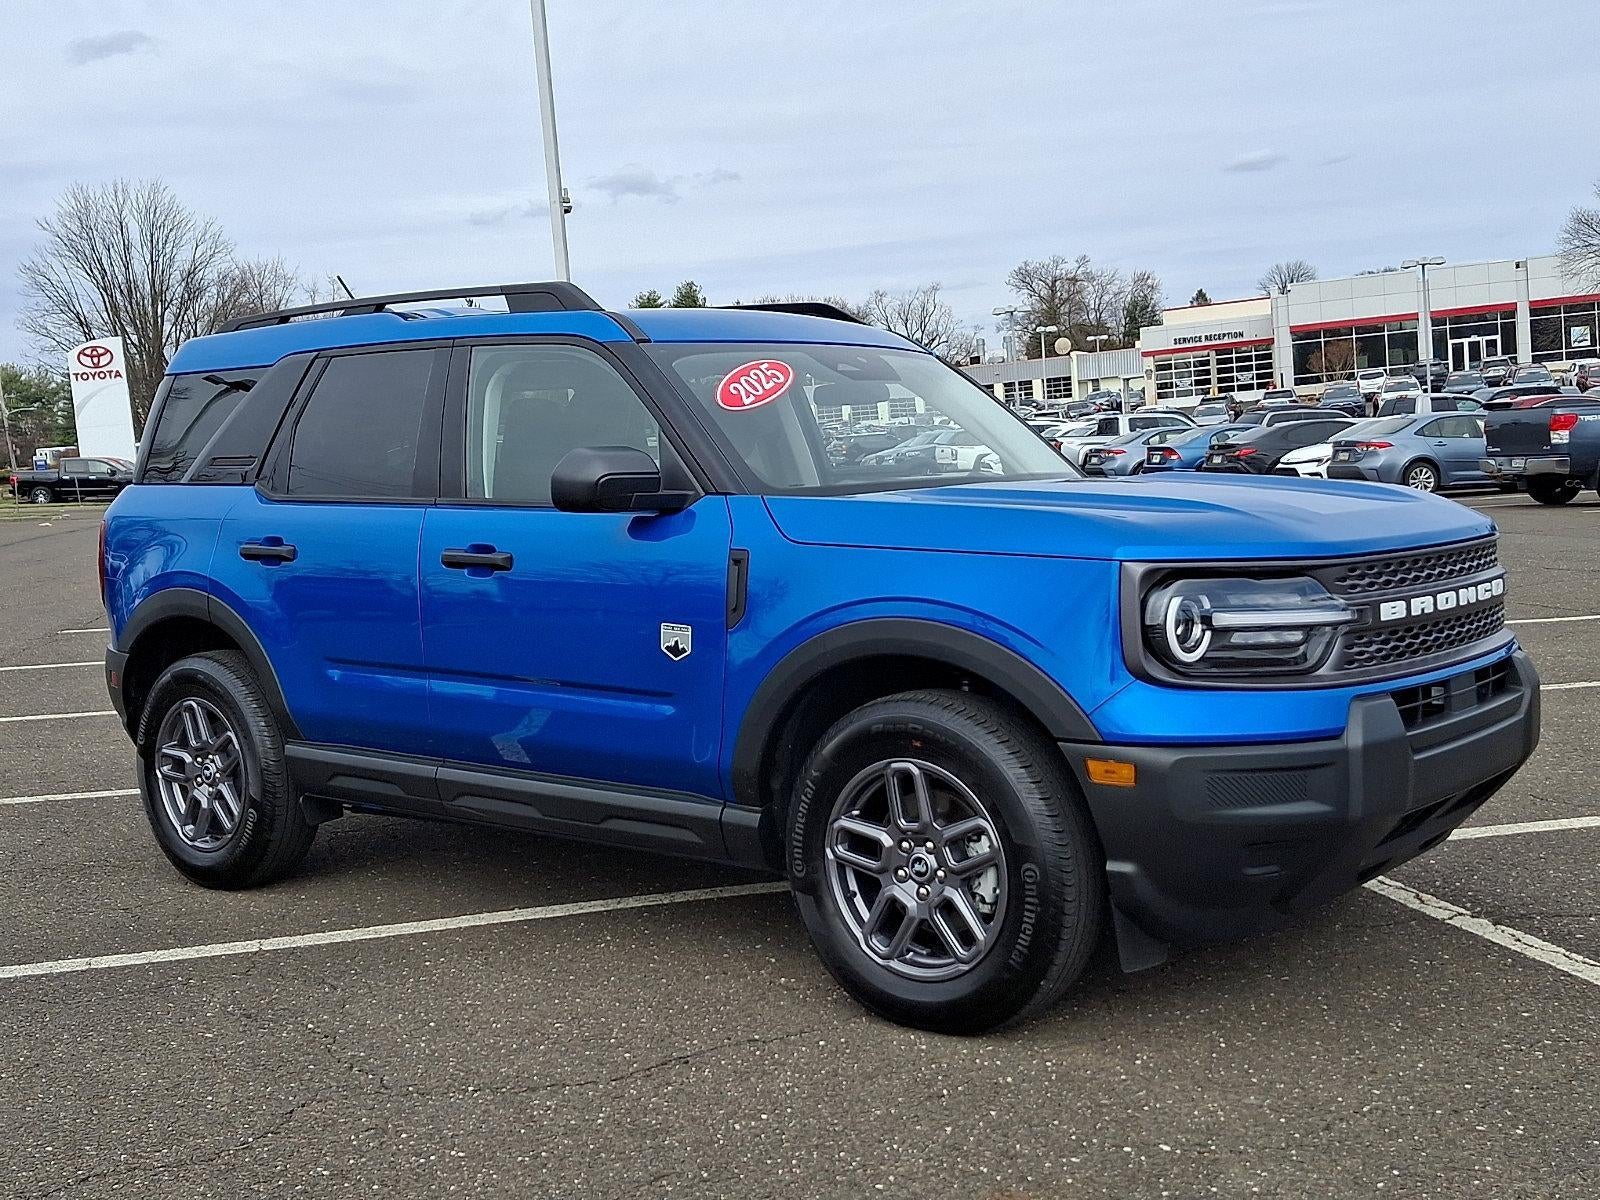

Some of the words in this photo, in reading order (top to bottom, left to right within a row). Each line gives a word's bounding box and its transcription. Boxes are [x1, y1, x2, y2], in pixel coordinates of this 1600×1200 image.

[1173, 335, 1203, 345] SERVICE
[1204, 331, 1244, 342] RECEPTION
[72, 370, 123, 381] TOYOTA
[729, 363, 785, 405] 2025
[1380, 578, 1504, 621] BRONCO
[792, 779, 816, 878] Continental
